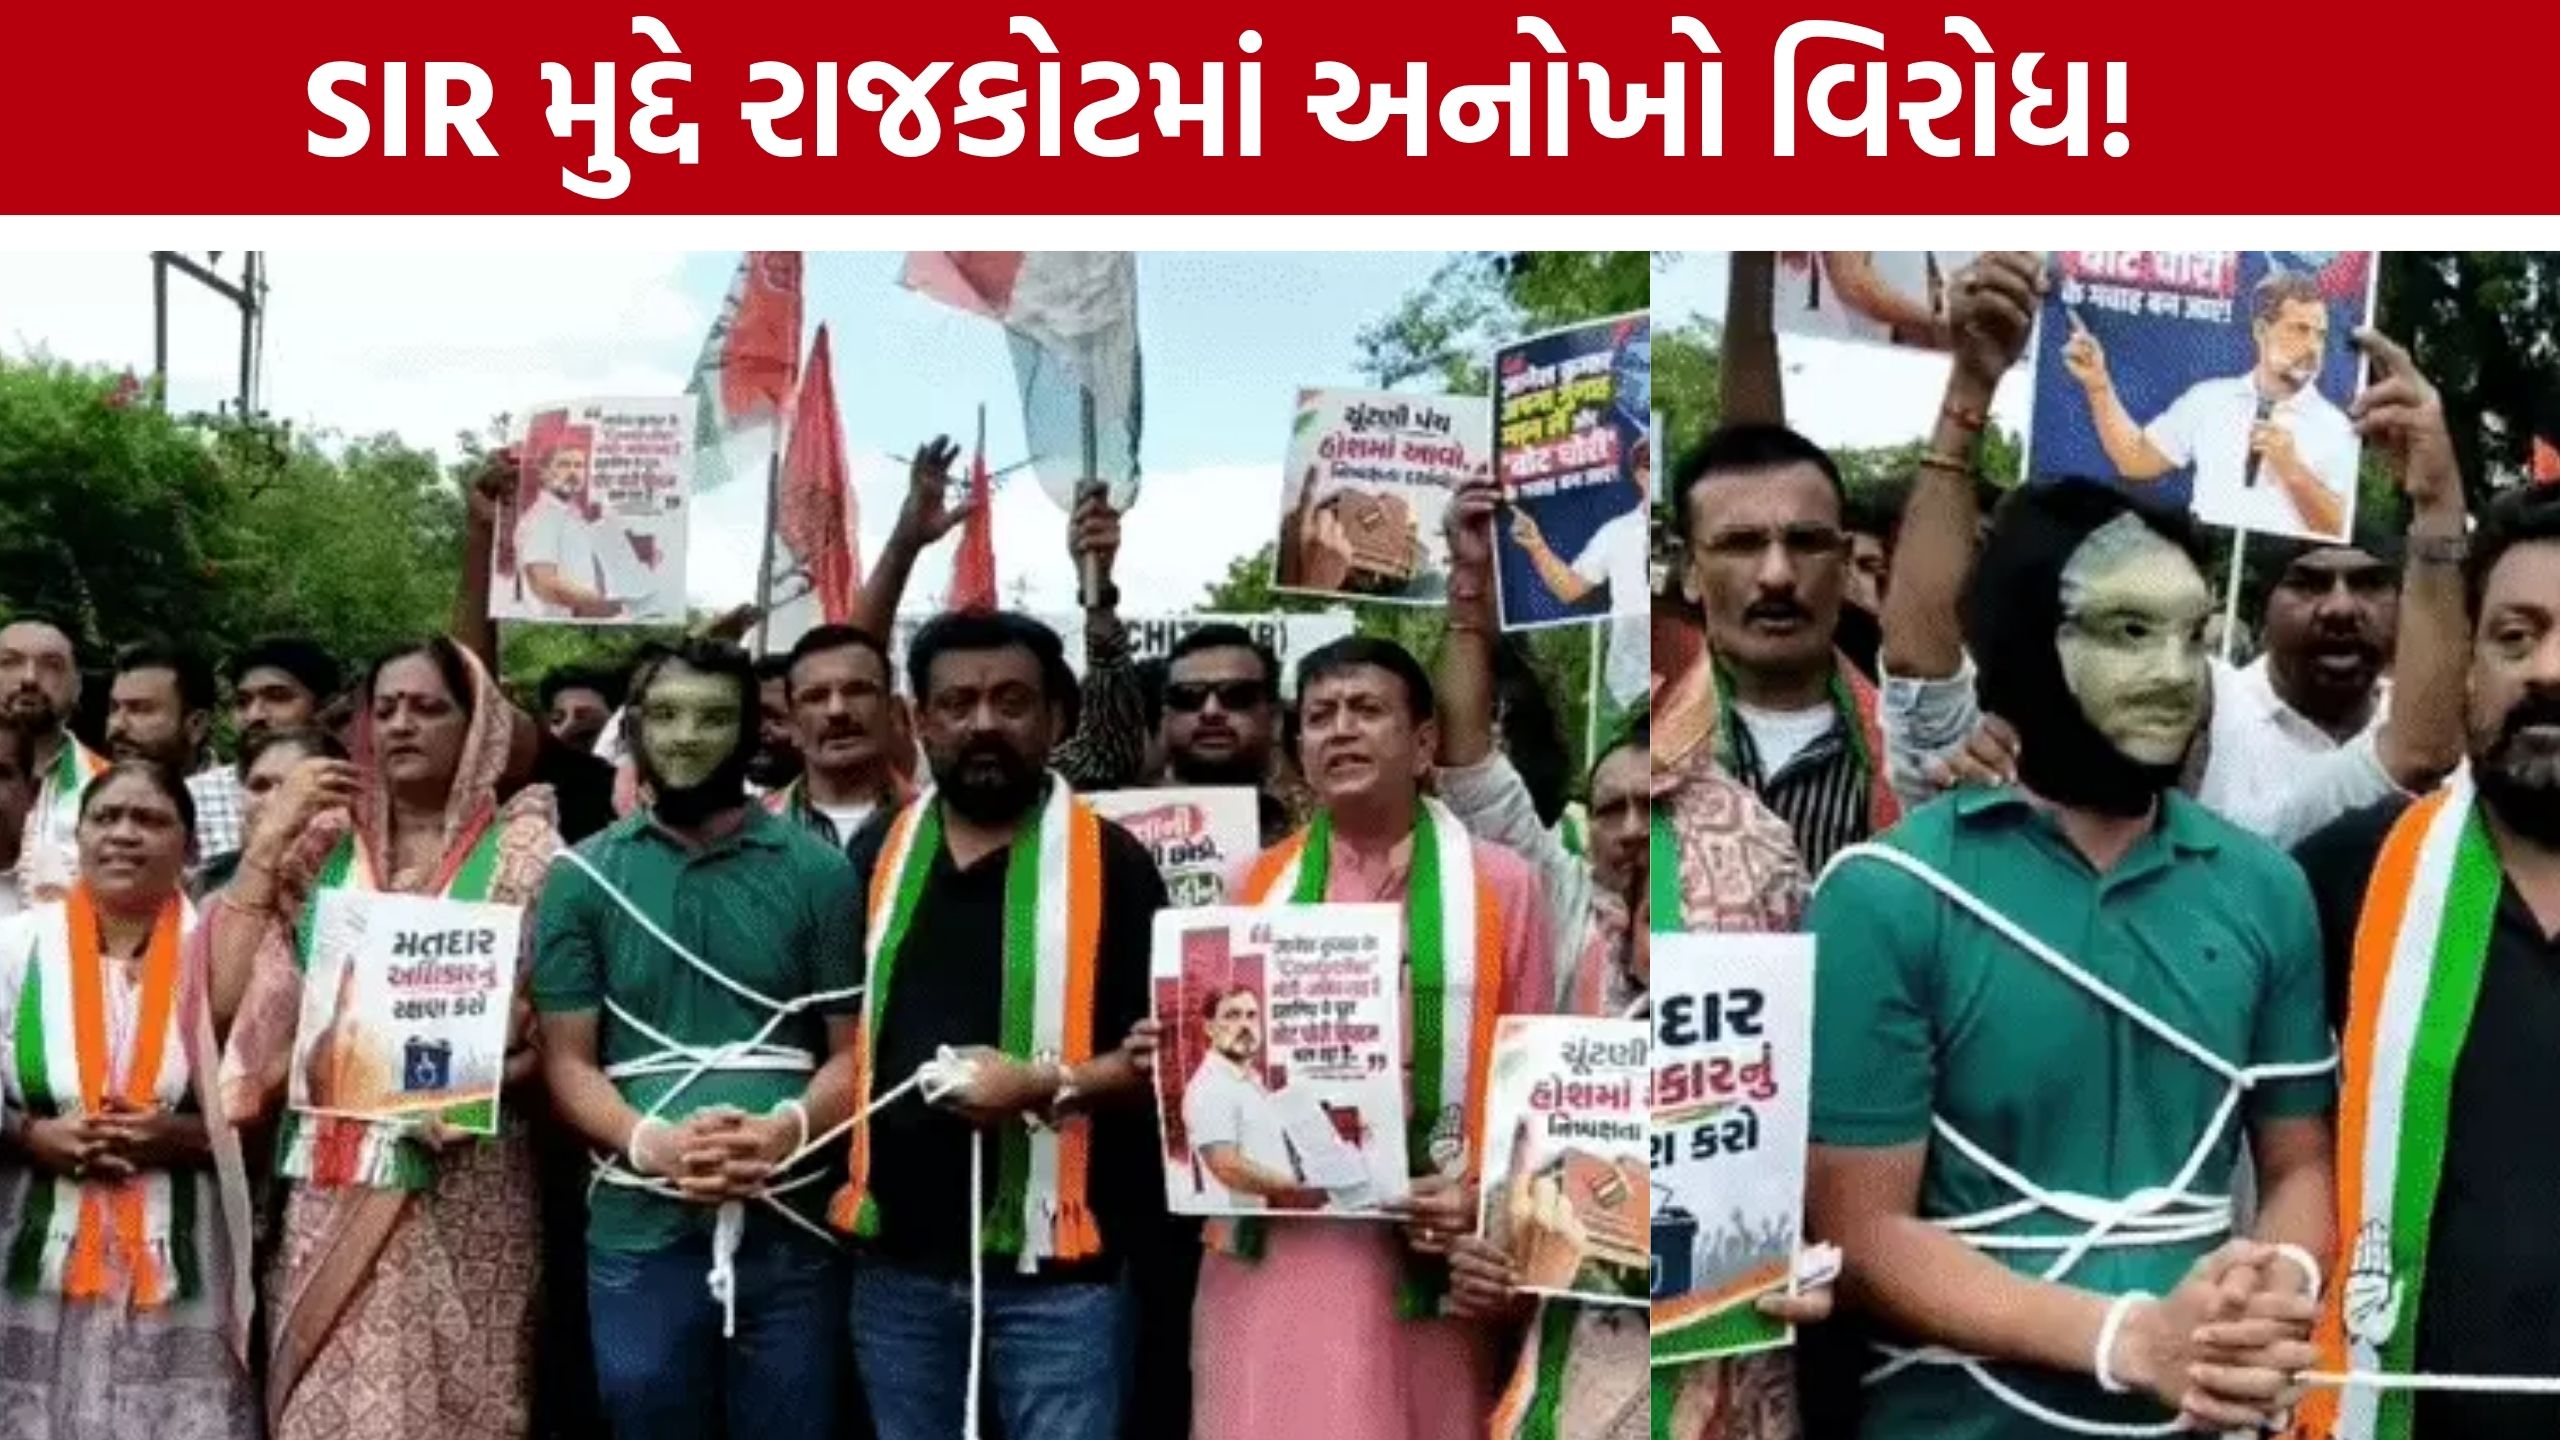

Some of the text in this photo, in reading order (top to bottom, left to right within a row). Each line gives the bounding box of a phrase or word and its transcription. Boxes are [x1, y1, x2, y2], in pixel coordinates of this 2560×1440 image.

[1344, 402, 1451, 434] ચૂંટણી પંચ
[391, 929, 497, 958] મતદાર
[453, 990, 487, 1016] કરો
[1651, 989, 1765, 1047] દાર
[1560, 1038, 1648, 1076] ચૂંટણી
[1528, 1071, 1631, 1111] હોશમાં
[1690, 1105, 1760, 1161] કરો
